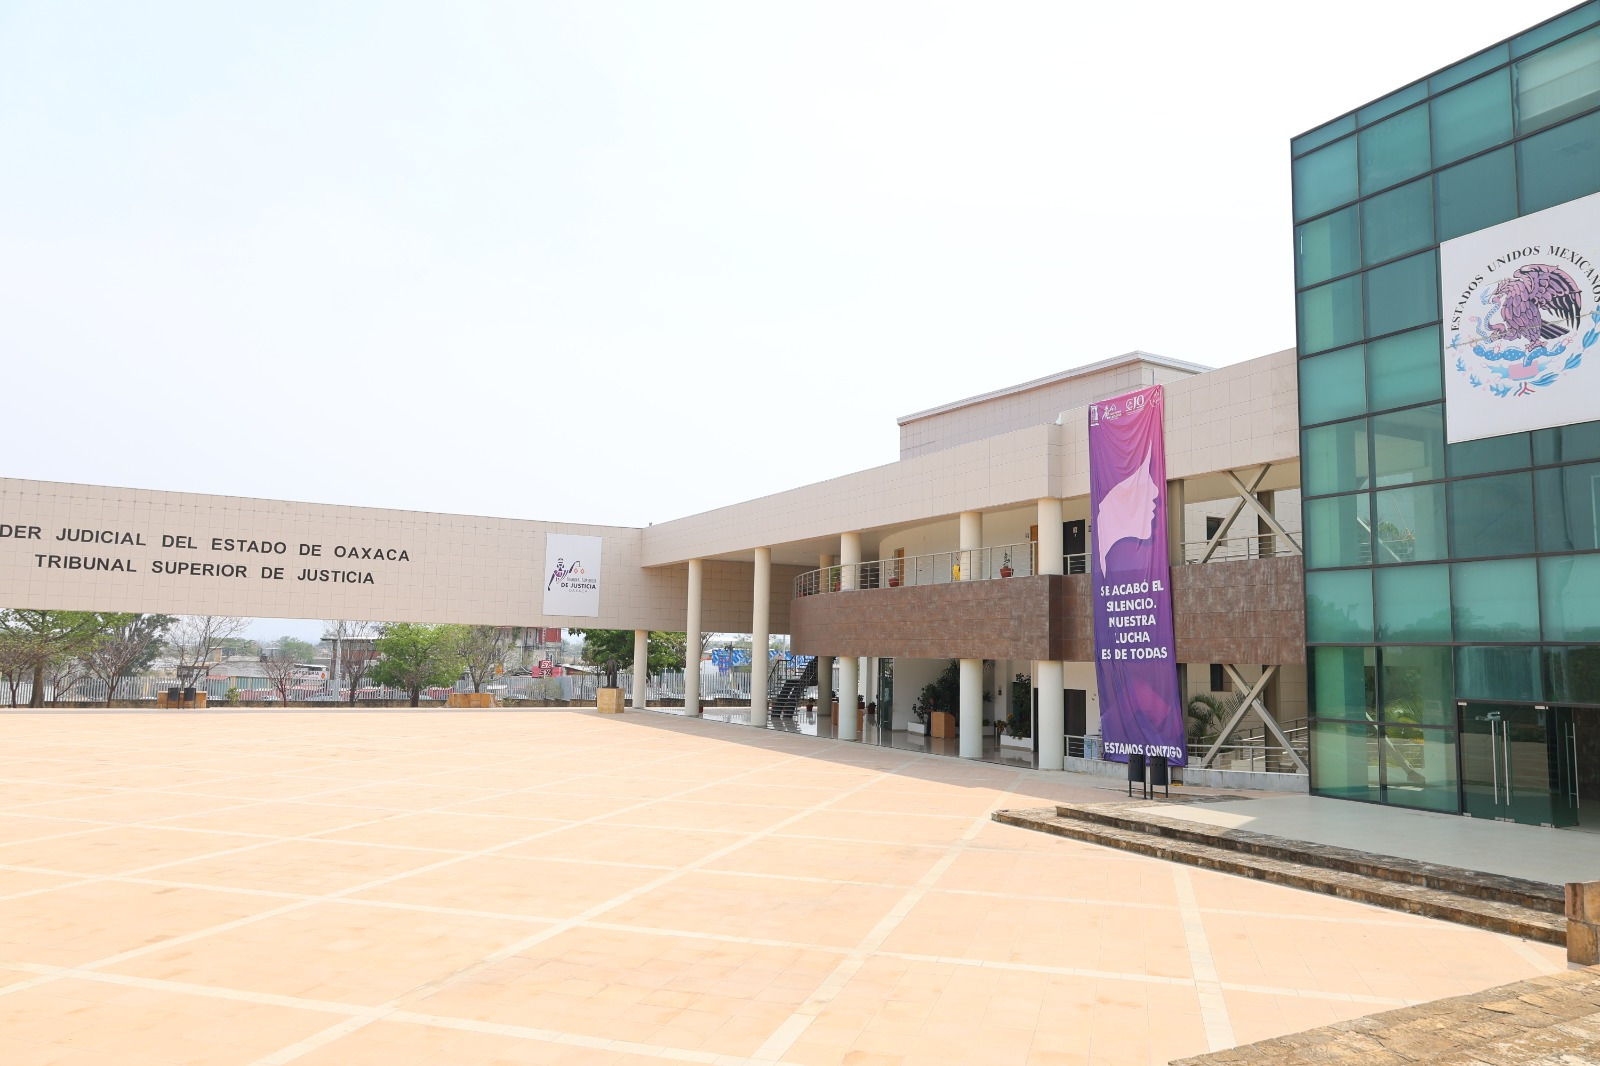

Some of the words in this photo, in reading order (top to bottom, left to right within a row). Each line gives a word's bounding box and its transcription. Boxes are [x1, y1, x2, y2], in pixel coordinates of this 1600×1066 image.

[1451, 274, 1483, 331] ESTADOS
[1486, 245, 1540, 272] UNIDOS
[0, 524, 42, 540] DER
[56, 528, 147, 546] JUDICIAL
[162, 534, 198, 550] DEL
[211, 538, 287, 555] ESTADO
[299, 543, 322, 557] DE
[334, 545, 410, 562] OAXACA
[35, 554, 137, 573] TRIBUNAL
[151, 560, 247, 578] SUPERIOR
[261, 566, 285, 580] DE
[297, 568, 375, 585] JUSTICIA
[1100, 585, 1111, 597] SE
[1111, 579, 1149, 596] ACABÓ
[1152, 579, 1165, 592] EL
[1106, 597, 1157, 612] SILENCIO.
[1108, 613, 1157, 628] NUESTRA
[1101, 648, 1112, 660] ES
[1114, 648, 1128, 660] DE
[1130, 646, 1168, 660] TODAS
[1104, 742, 1144, 755] ESTAMOS
[1145, 744, 1183, 759] CONTIGO
